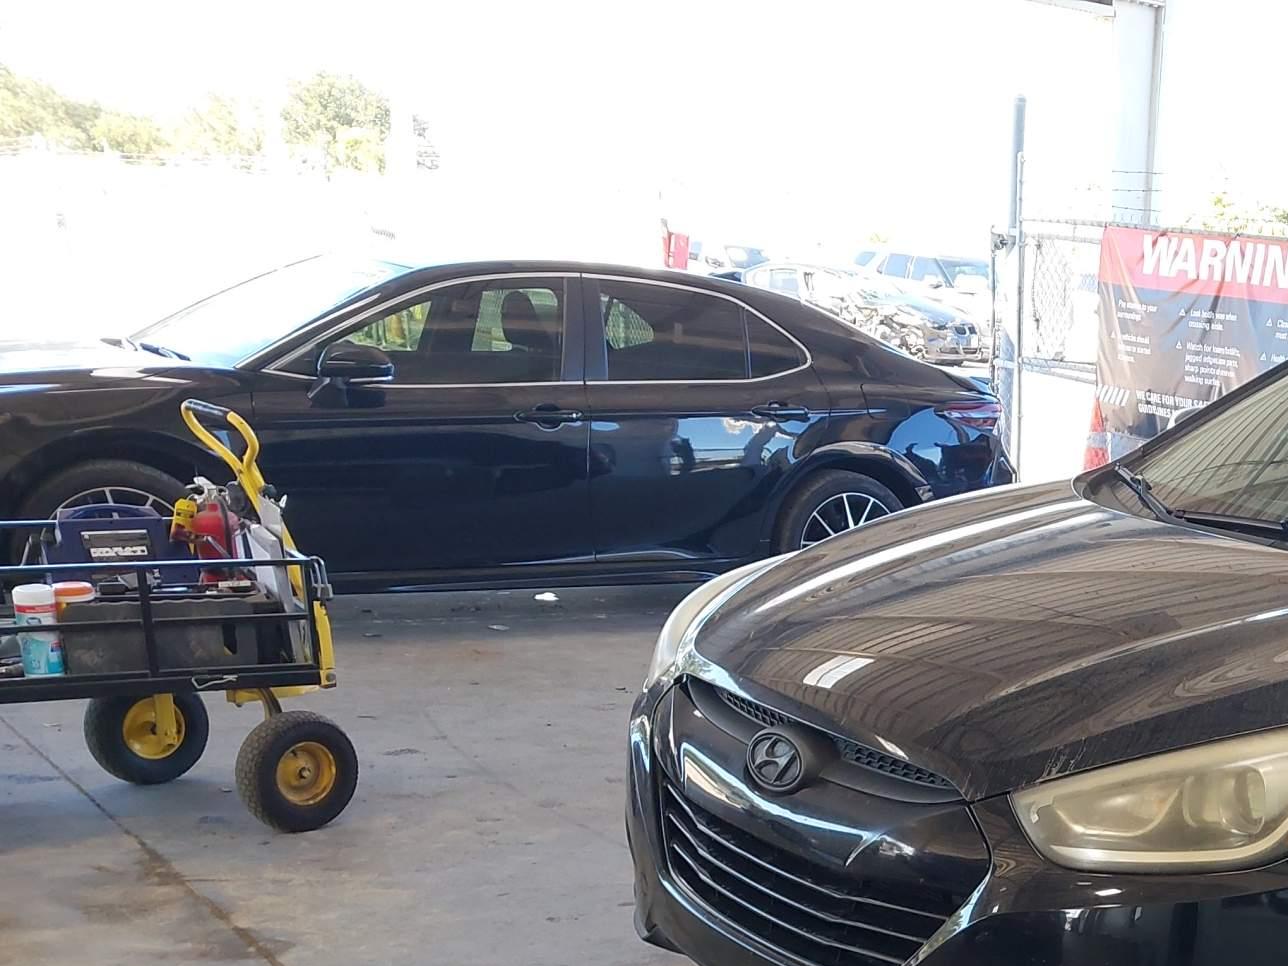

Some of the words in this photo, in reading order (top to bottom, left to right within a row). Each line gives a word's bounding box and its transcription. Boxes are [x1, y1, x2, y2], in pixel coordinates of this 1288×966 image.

[1186, 341, 1203, 352] Watch
[1203, 343, 1212, 353] for
[1184, 352, 1202, 363] jagged
[1136, 389, 1146, 401] WE
[1146, 391, 1162, 404] CARE
[1161, 394, 1175, 406] FOR
[1174, 395, 1193, 409] YOUR
